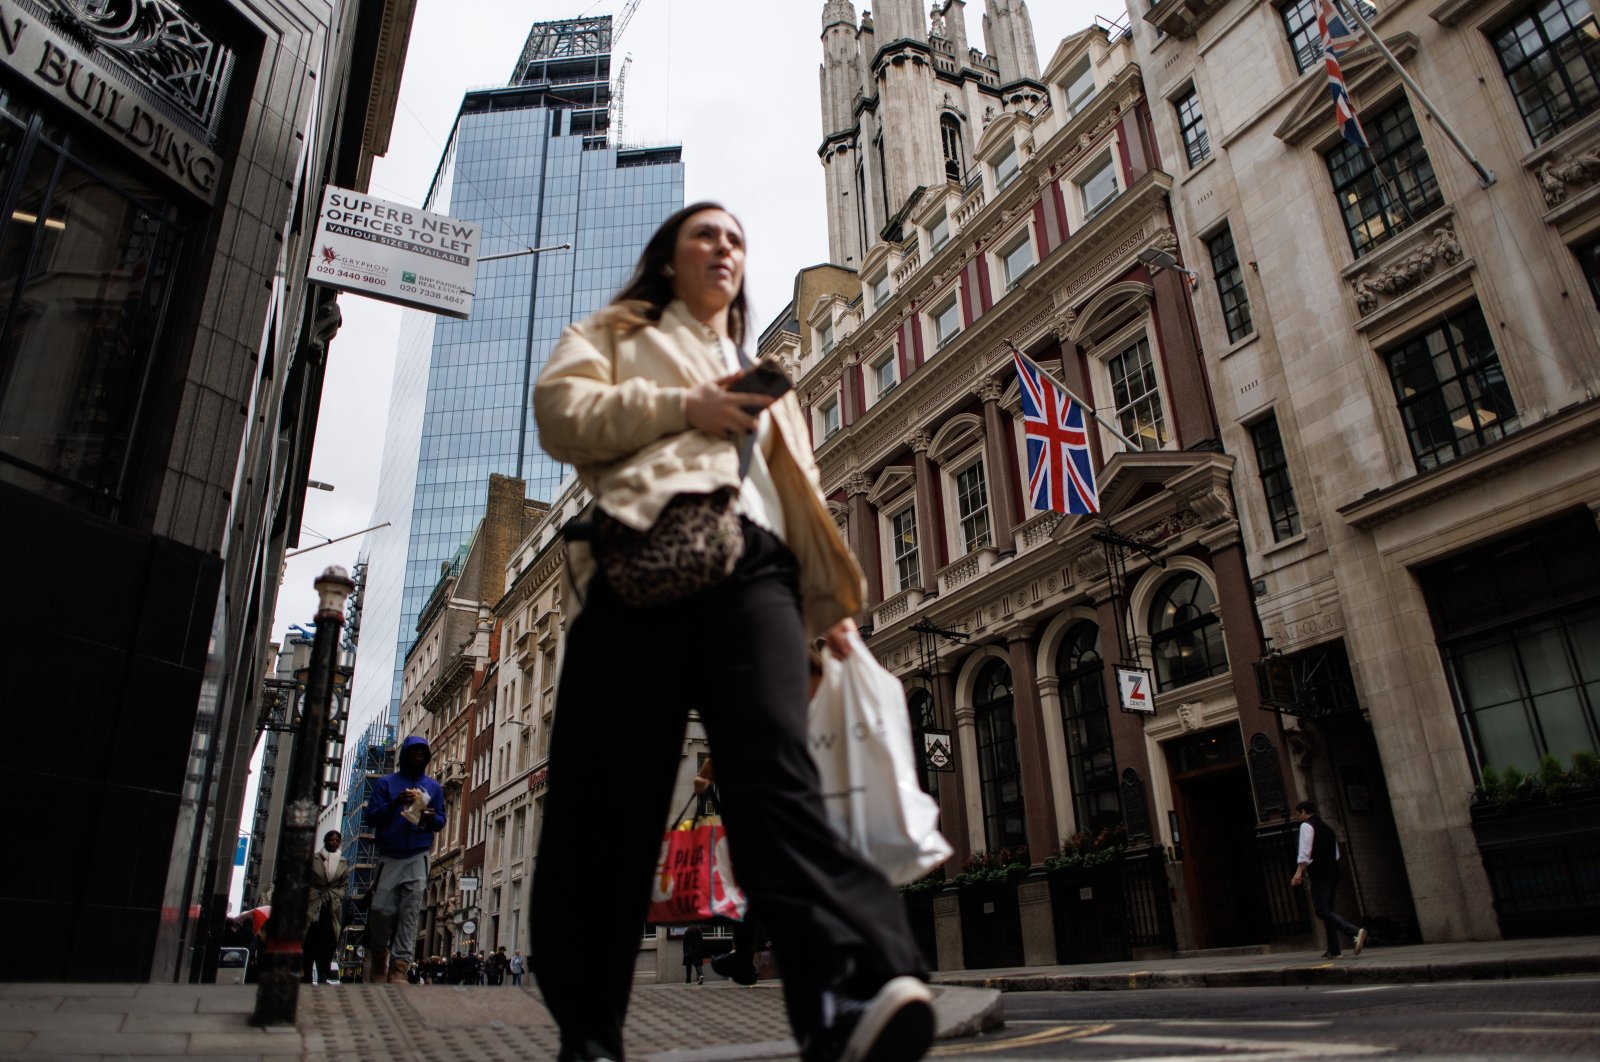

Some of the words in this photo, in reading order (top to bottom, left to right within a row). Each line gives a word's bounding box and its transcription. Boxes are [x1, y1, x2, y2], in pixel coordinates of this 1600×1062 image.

[34, 40, 215, 192] BUILDING
[330, 194, 413, 225] SUPERB
[422, 218, 474, 240] NEW
[327, 209, 403, 236] OFFICES
[409, 228, 434, 244] TO
[440, 239, 473, 254] LET
[329, 224, 377, 242] VARIOUS
[380, 236, 409, 249] SIZES
[411, 245, 467, 266] AVAILABLE
[316, 265, 335, 275] 020
[337, 270, 361, 280] 3440
[363, 275, 386, 286] 9800
[341, 257, 389, 272] GRYPHON
[418, 275, 435, 283] BNP
[418, 281, 437, 289] REAL
[400, 284, 417, 293] 020
[419, 289, 441, 299] 7338
[1303, 612, 1339, 634] COURT
[1128, 675, 1146, 700] Z
